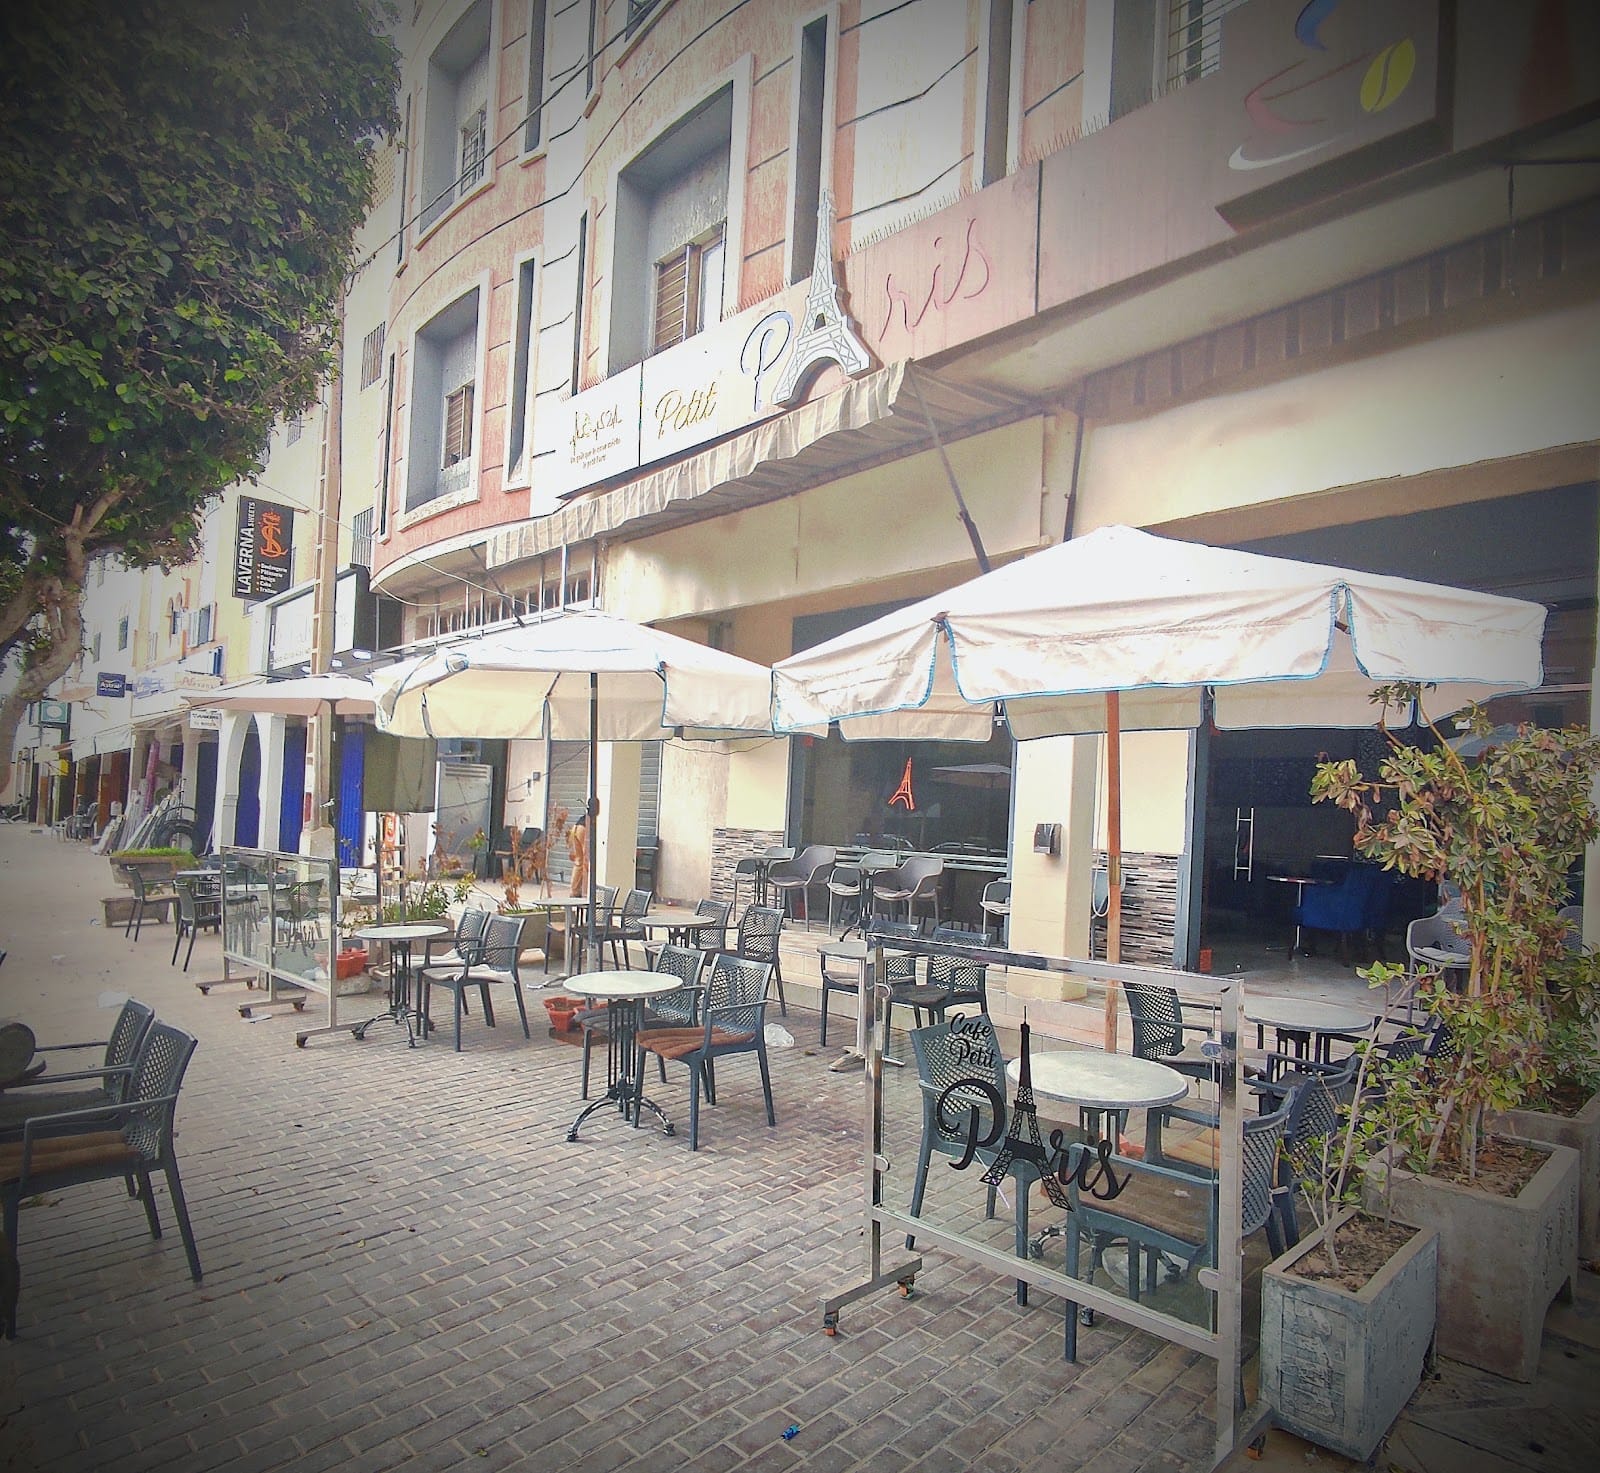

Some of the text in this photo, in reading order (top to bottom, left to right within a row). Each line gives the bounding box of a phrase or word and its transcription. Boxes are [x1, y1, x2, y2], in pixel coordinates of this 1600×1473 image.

[655, 381, 717, 439] Petit
[238, 502, 255, 594] LAVERNA SWEETS
[950, 1012, 992, 1040] Cafe
[950, 1037, 997, 1069] Petit
